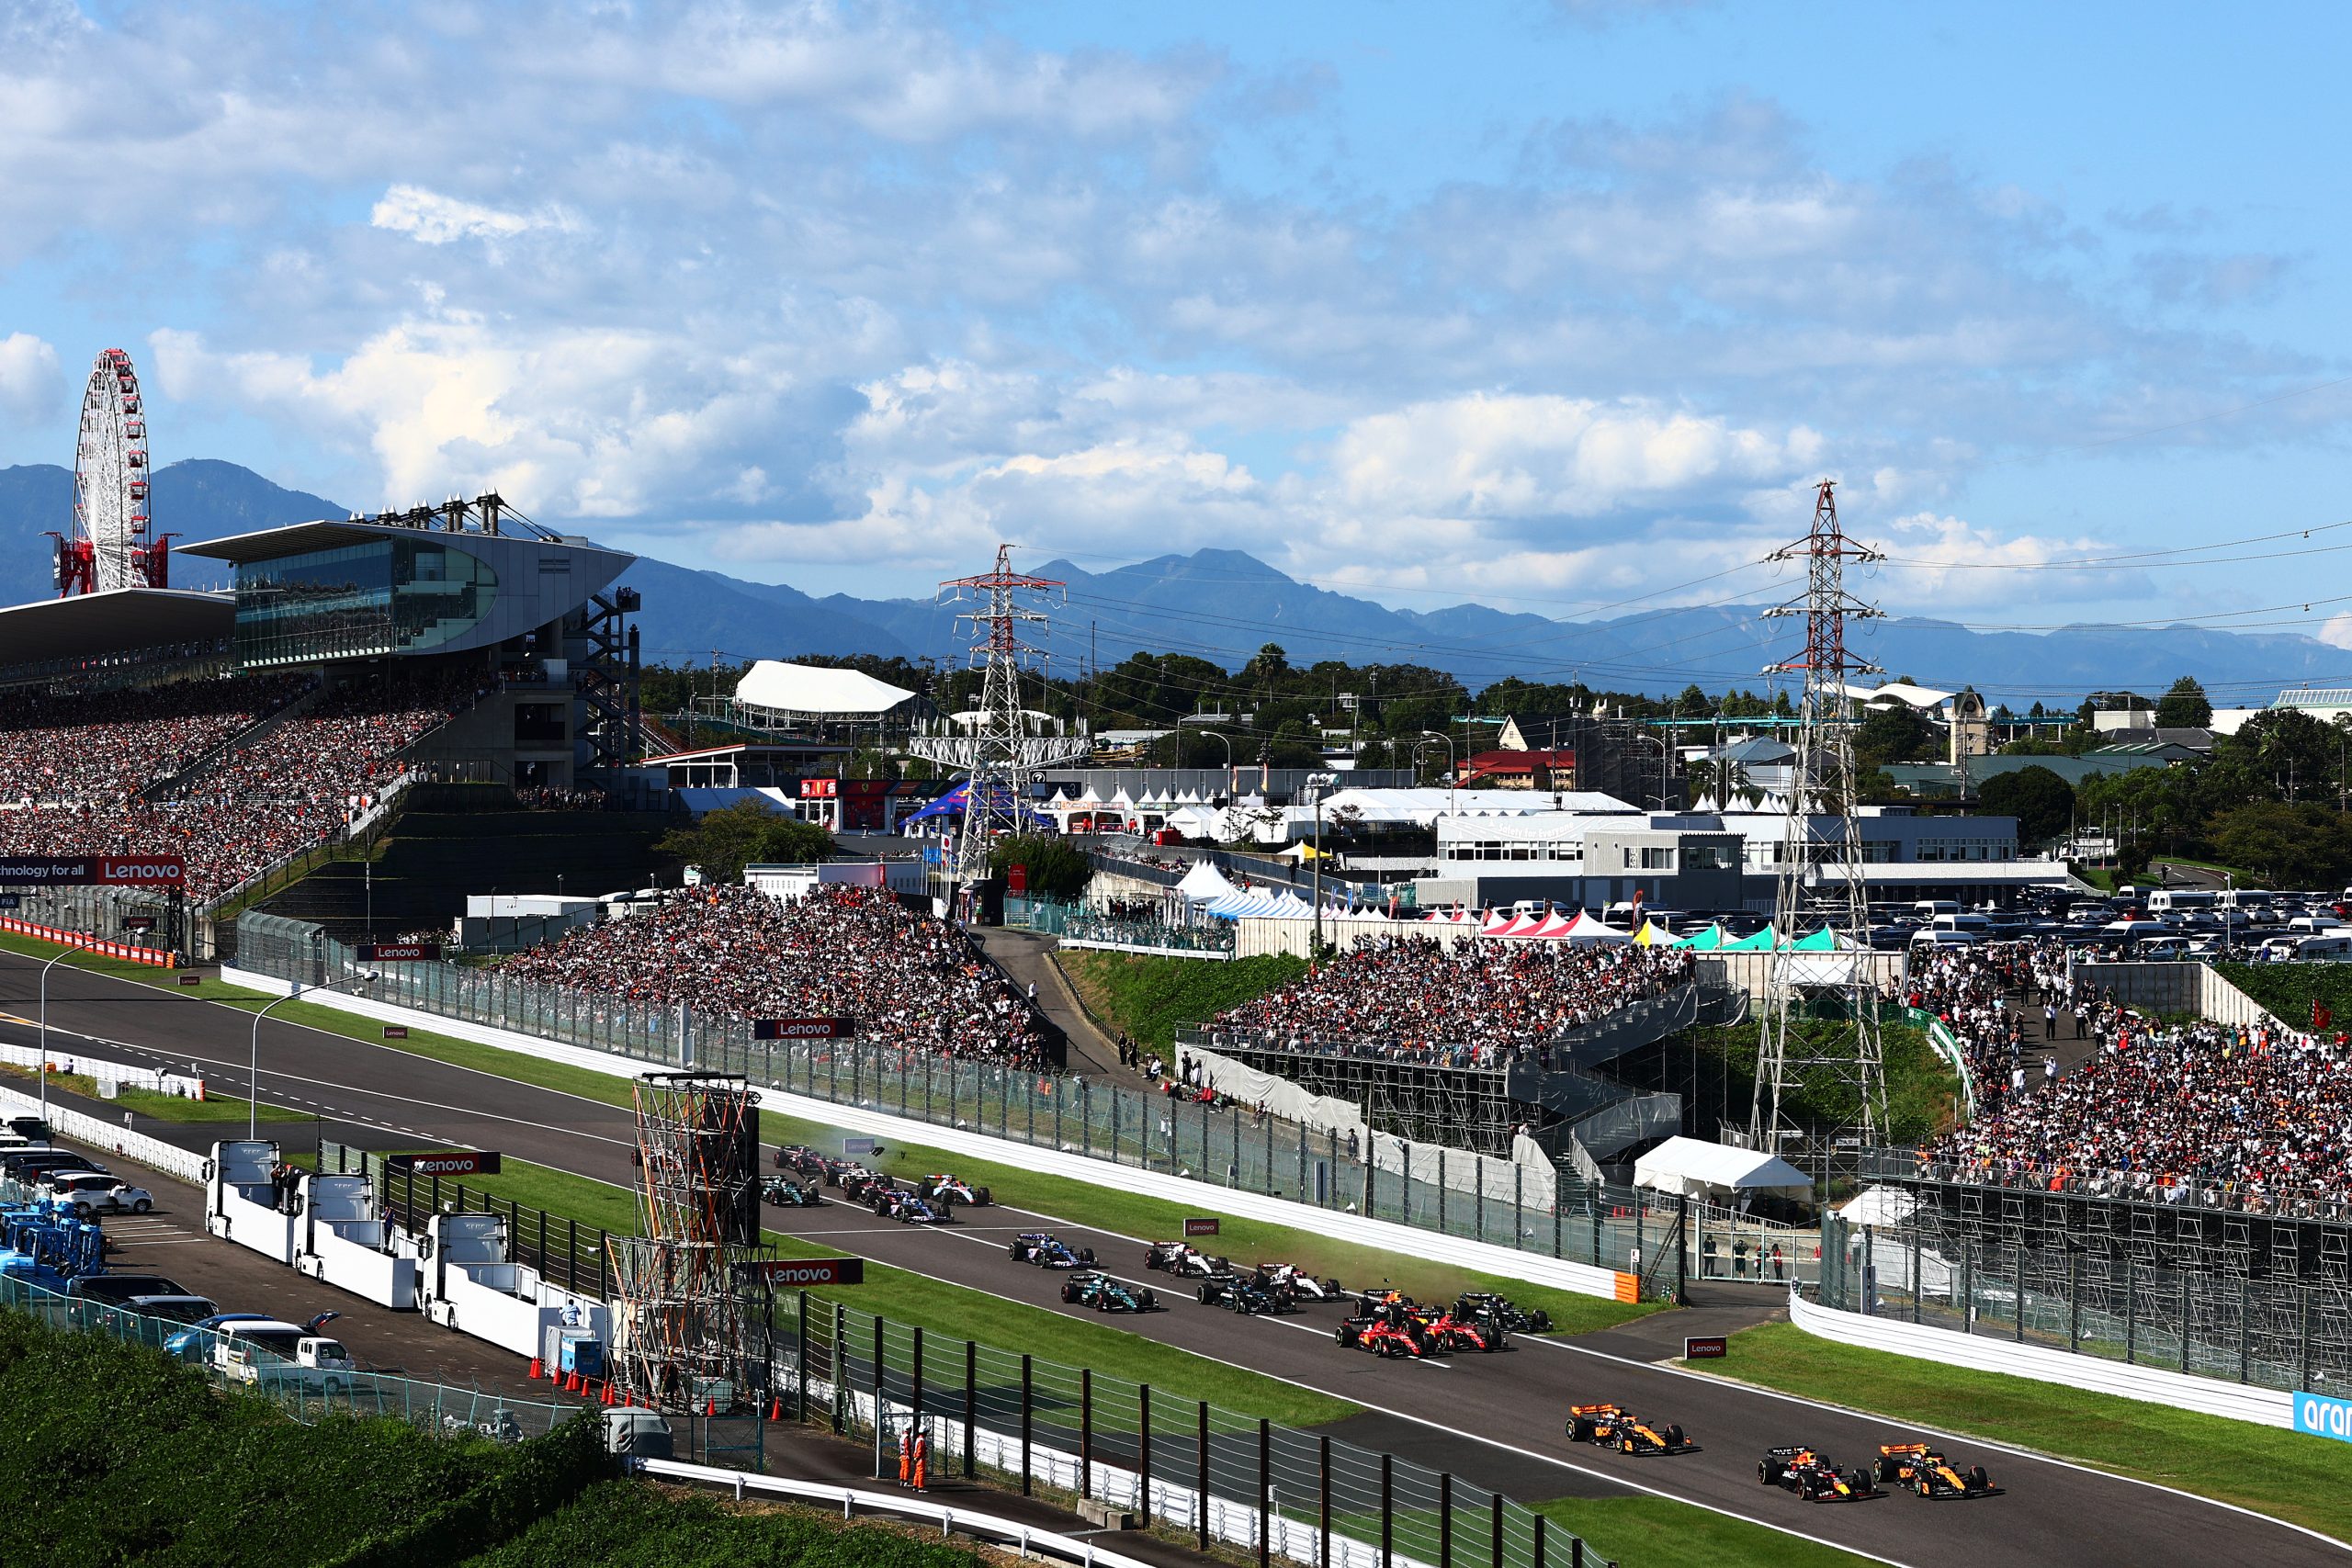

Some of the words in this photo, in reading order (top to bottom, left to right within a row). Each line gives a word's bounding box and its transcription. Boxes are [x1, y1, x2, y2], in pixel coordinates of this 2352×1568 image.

[1525, 829, 1536, 839] for
[51, 864, 69, 875] for
[71, 864, 85, 875] all
[105, 863, 179, 878] Lenovo
[378, 947, 420, 957] Lenovo
[780, 1023, 831, 1035] Lenovo
[416, 1160, 474, 1171] enovo
